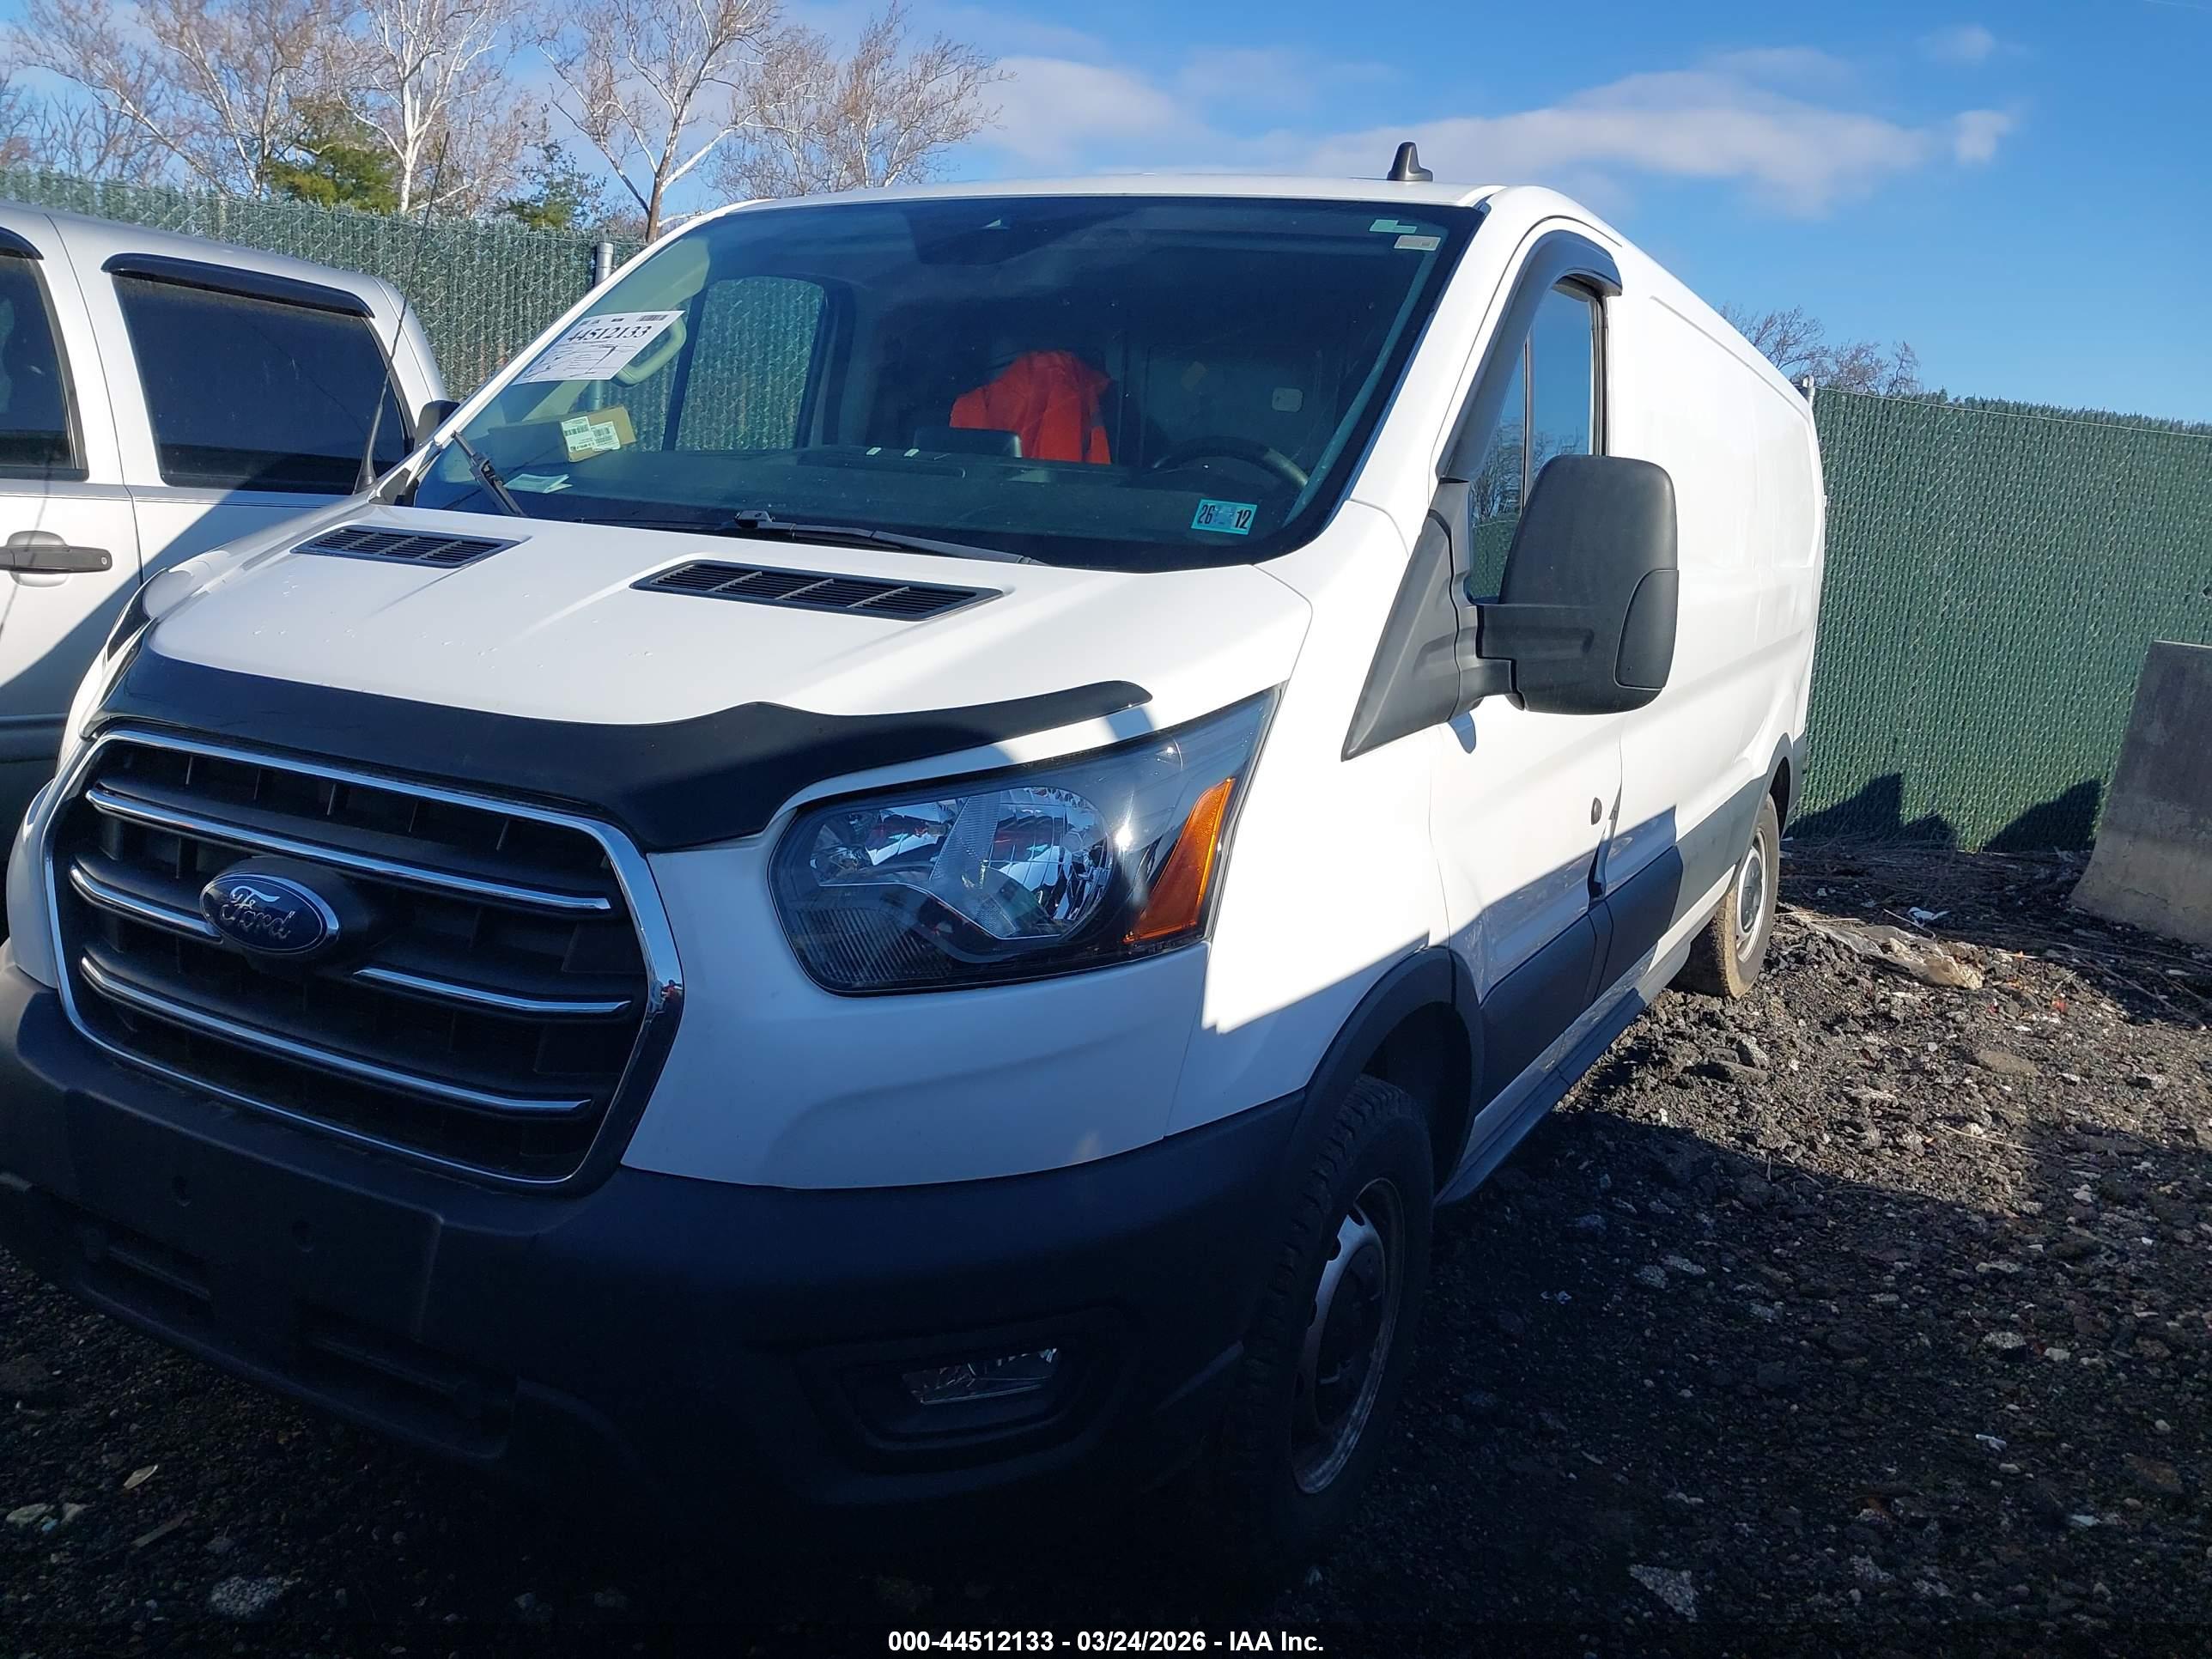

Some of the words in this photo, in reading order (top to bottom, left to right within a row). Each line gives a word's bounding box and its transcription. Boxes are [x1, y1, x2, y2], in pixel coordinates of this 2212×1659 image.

[568, 325, 652, 343] 44512133
[1198, 504, 1216, 525] 26
[1235, 509, 1252, 530] 12
[220, 885, 296, 940] Ford
